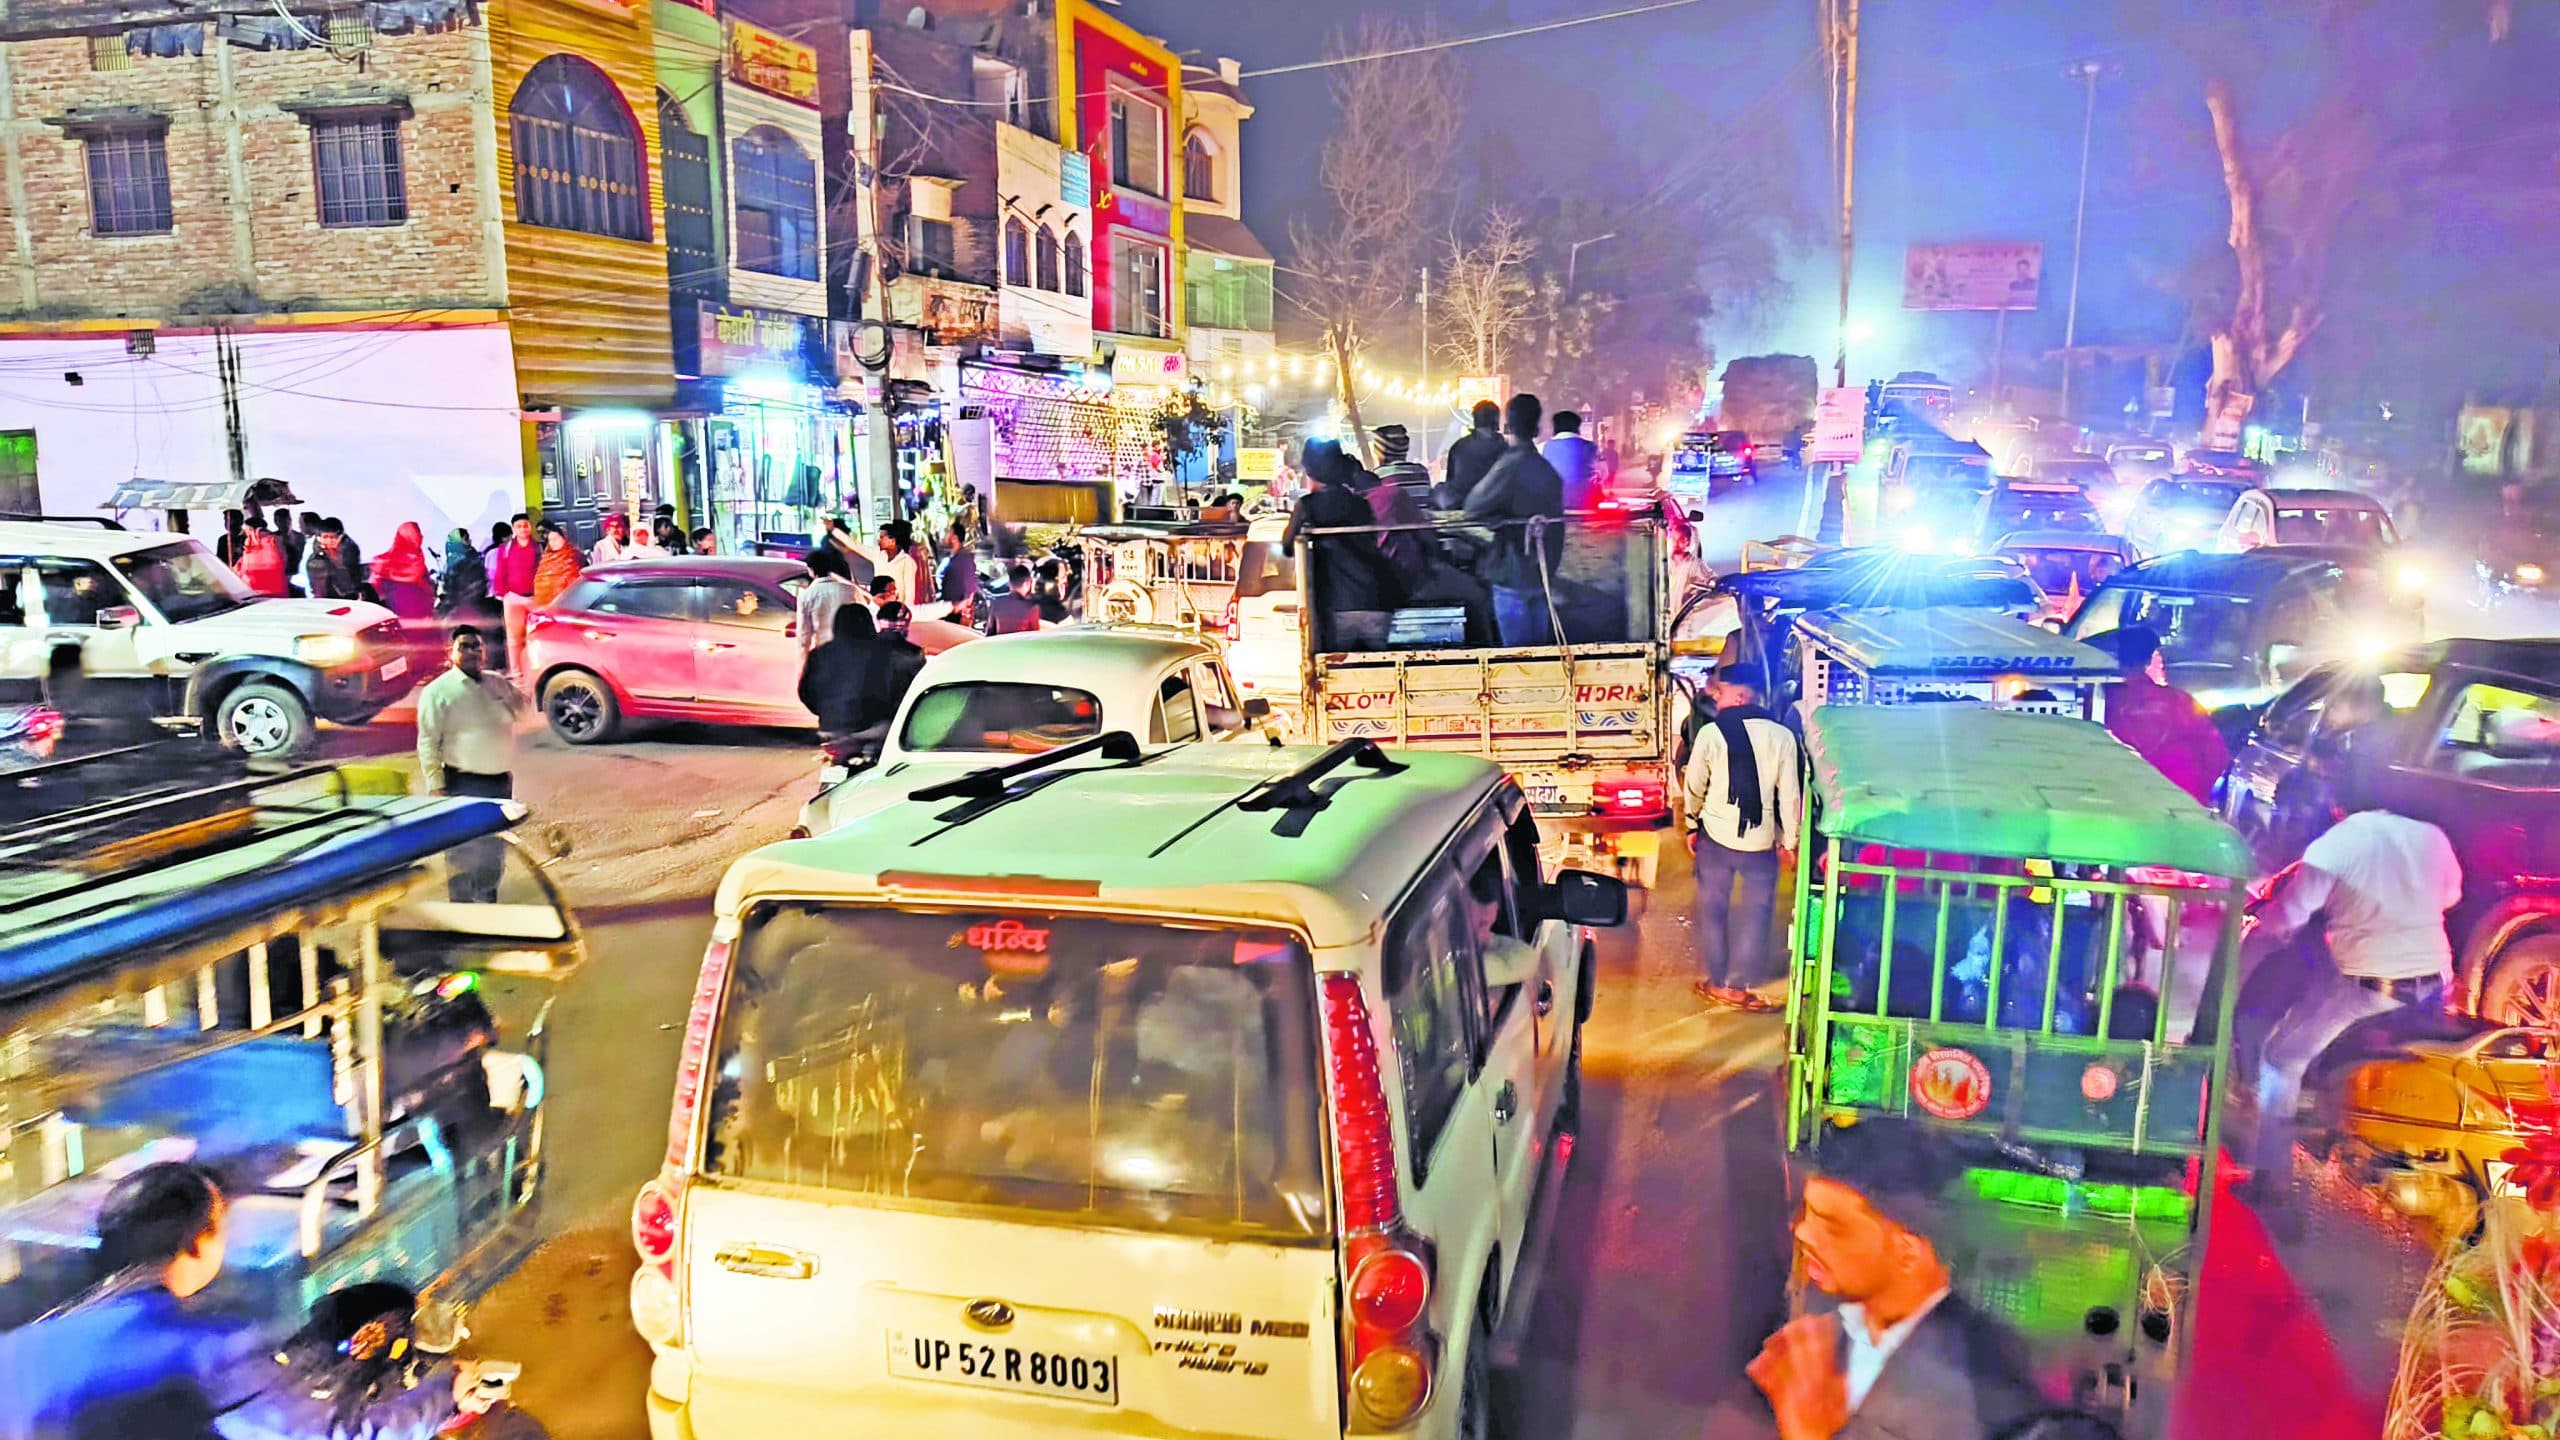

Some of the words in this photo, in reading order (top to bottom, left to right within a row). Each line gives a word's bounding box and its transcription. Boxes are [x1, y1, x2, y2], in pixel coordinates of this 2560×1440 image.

[914, 1337, 950, 1371] UP
[958, 1343, 997, 1379] 52
[1004, 1347, 1021, 1382] R
[1029, 1351, 1110, 1393] 8003
